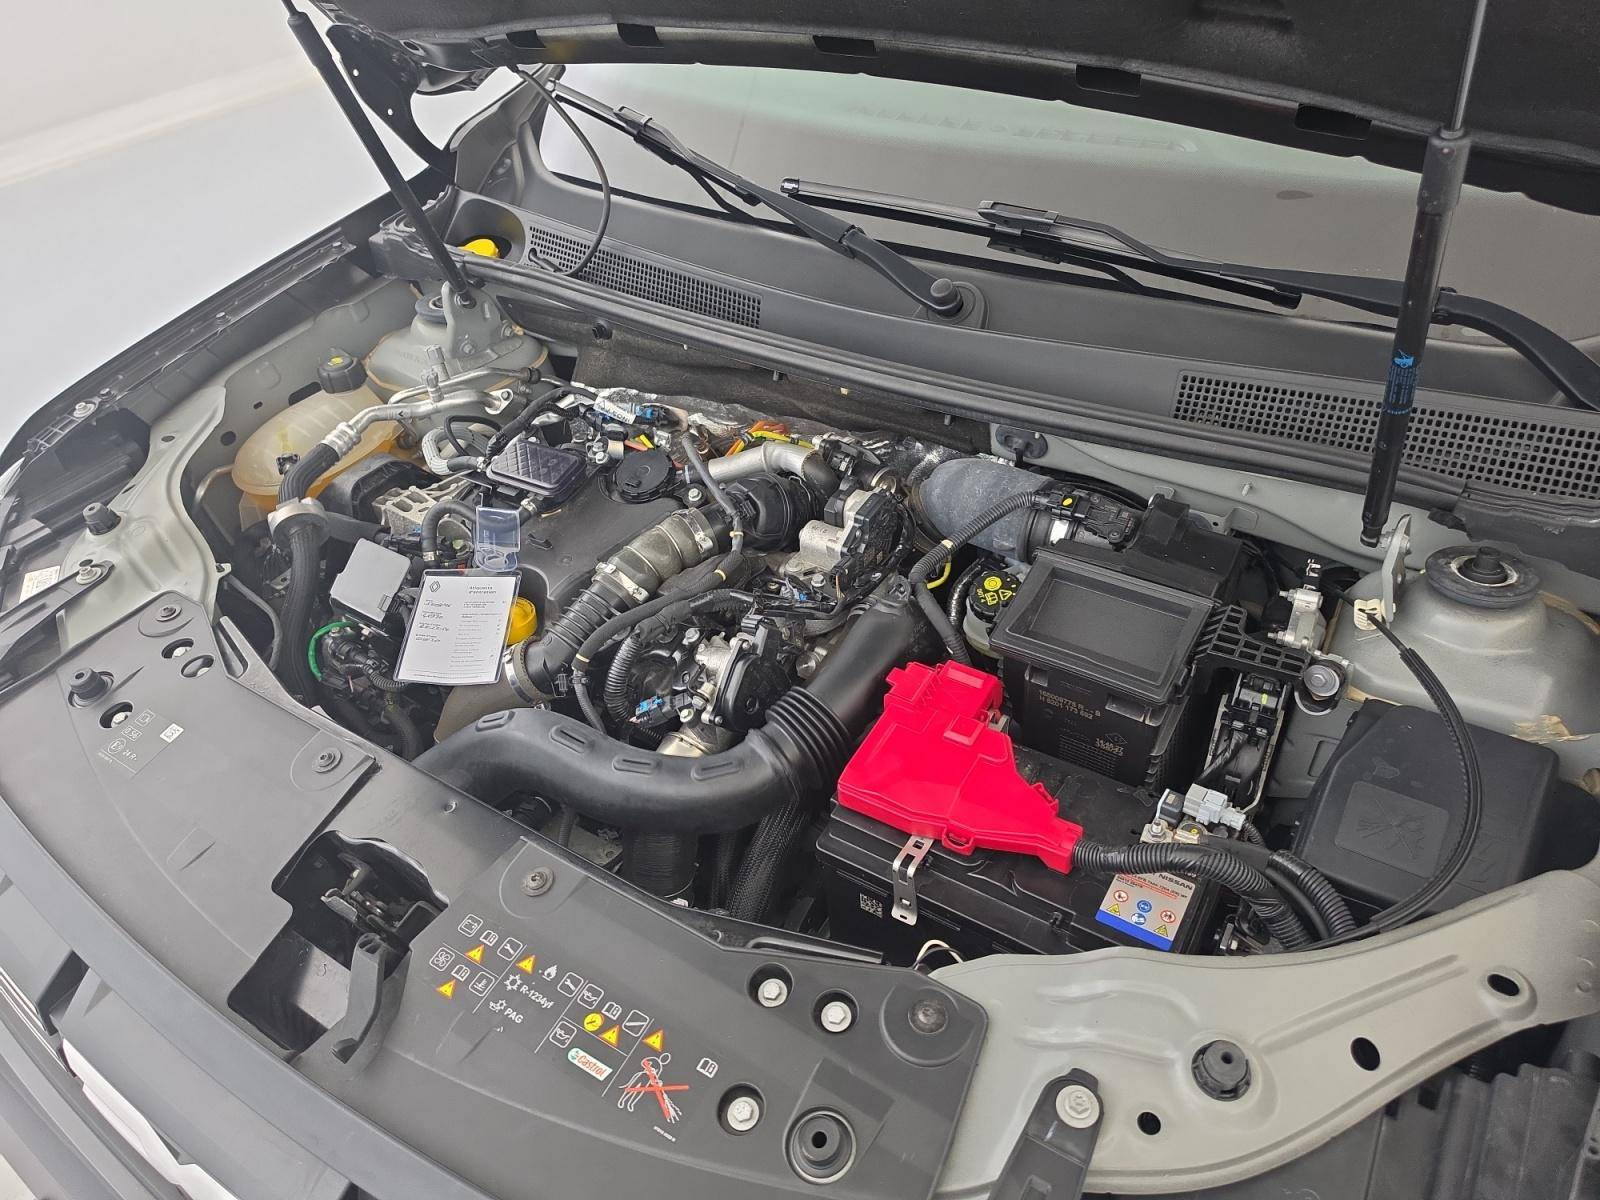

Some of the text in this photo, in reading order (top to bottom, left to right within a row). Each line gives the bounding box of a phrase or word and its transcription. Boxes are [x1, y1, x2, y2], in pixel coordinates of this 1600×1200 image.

[1158, 873, 1193, 890] NISSAN
[519, 984, 555, 1009] R-1234yf
[504, 1006, 524, 1025] PAG
[576, 1055, 608, 1078] Castrol
